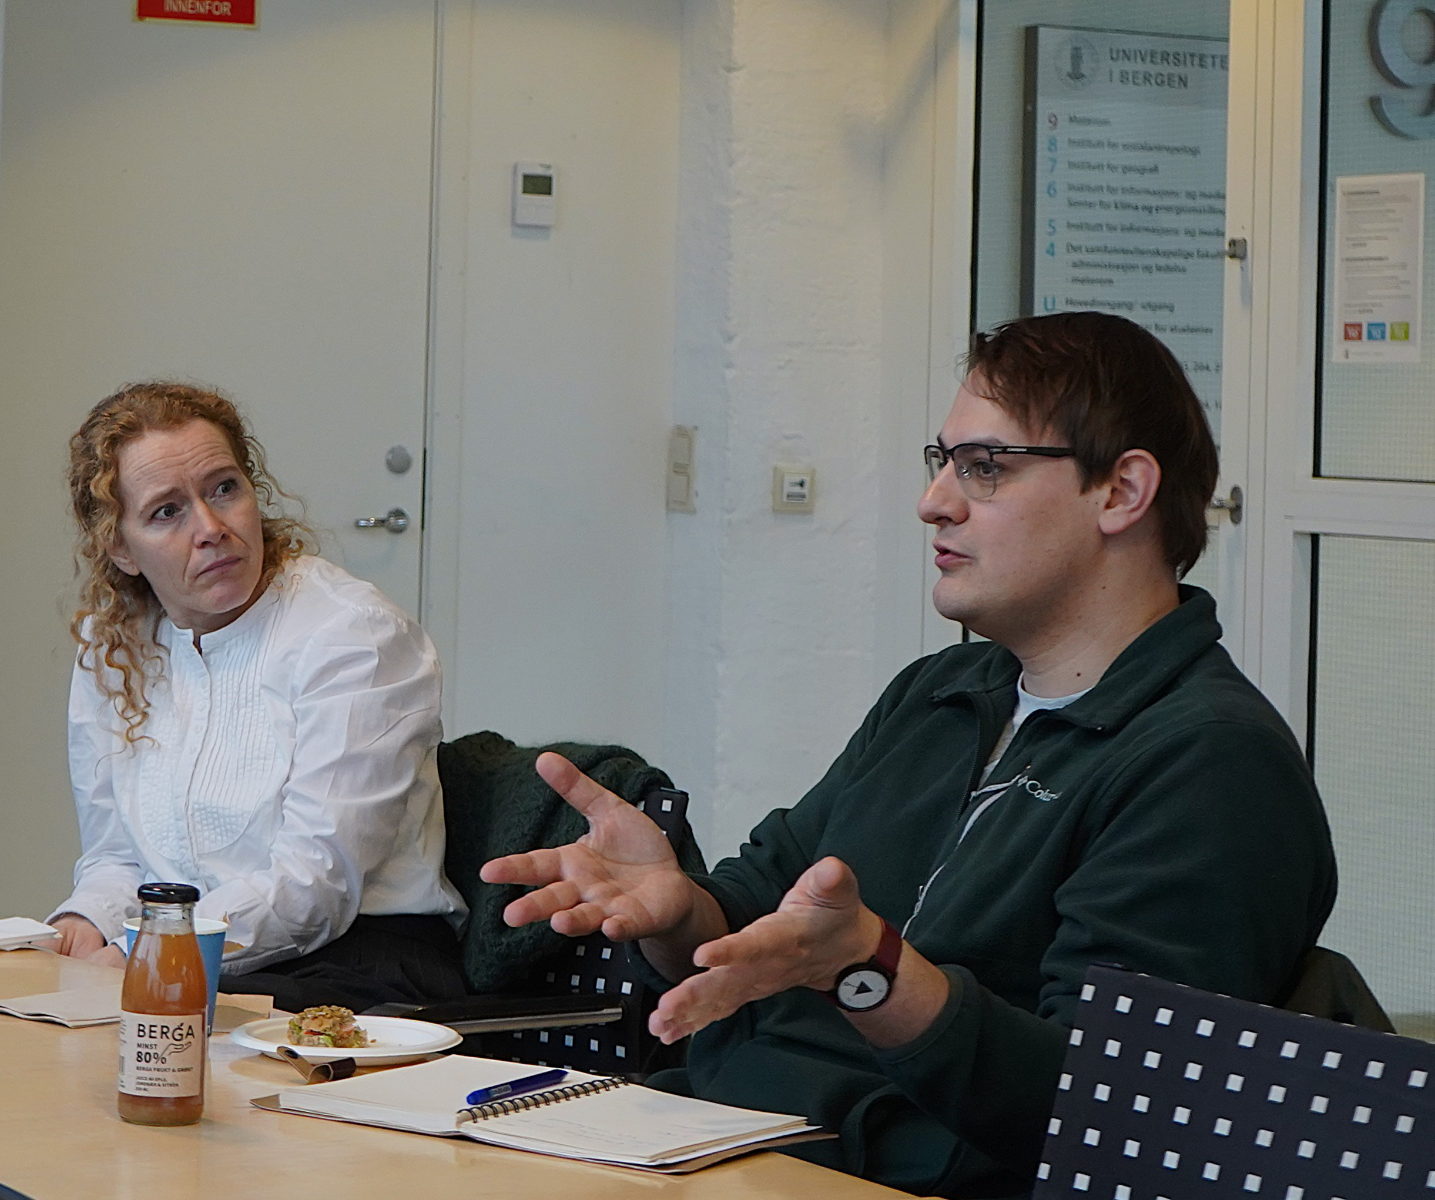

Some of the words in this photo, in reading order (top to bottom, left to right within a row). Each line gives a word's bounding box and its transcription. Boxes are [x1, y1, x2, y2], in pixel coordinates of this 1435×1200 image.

[165, 1, 232, 16] INNENFOR
[1109, 46, 1229, 70] UNIVERSITETE
[1119, 69, 1189, 90] BERGEN
[1368, 0, 1435, 141] 9
[1048, 112, 1058, 131] 9
[1046, 180, 1057, 198] 6
[1047, 218, 1057, 237] 5
[1045, 242, 1056, 258] 4
[137, 1022, 196, 1042] BERGA
[136, 1042, 158, 1050] MINST
[136, 1051, 167, 1065] 80%
